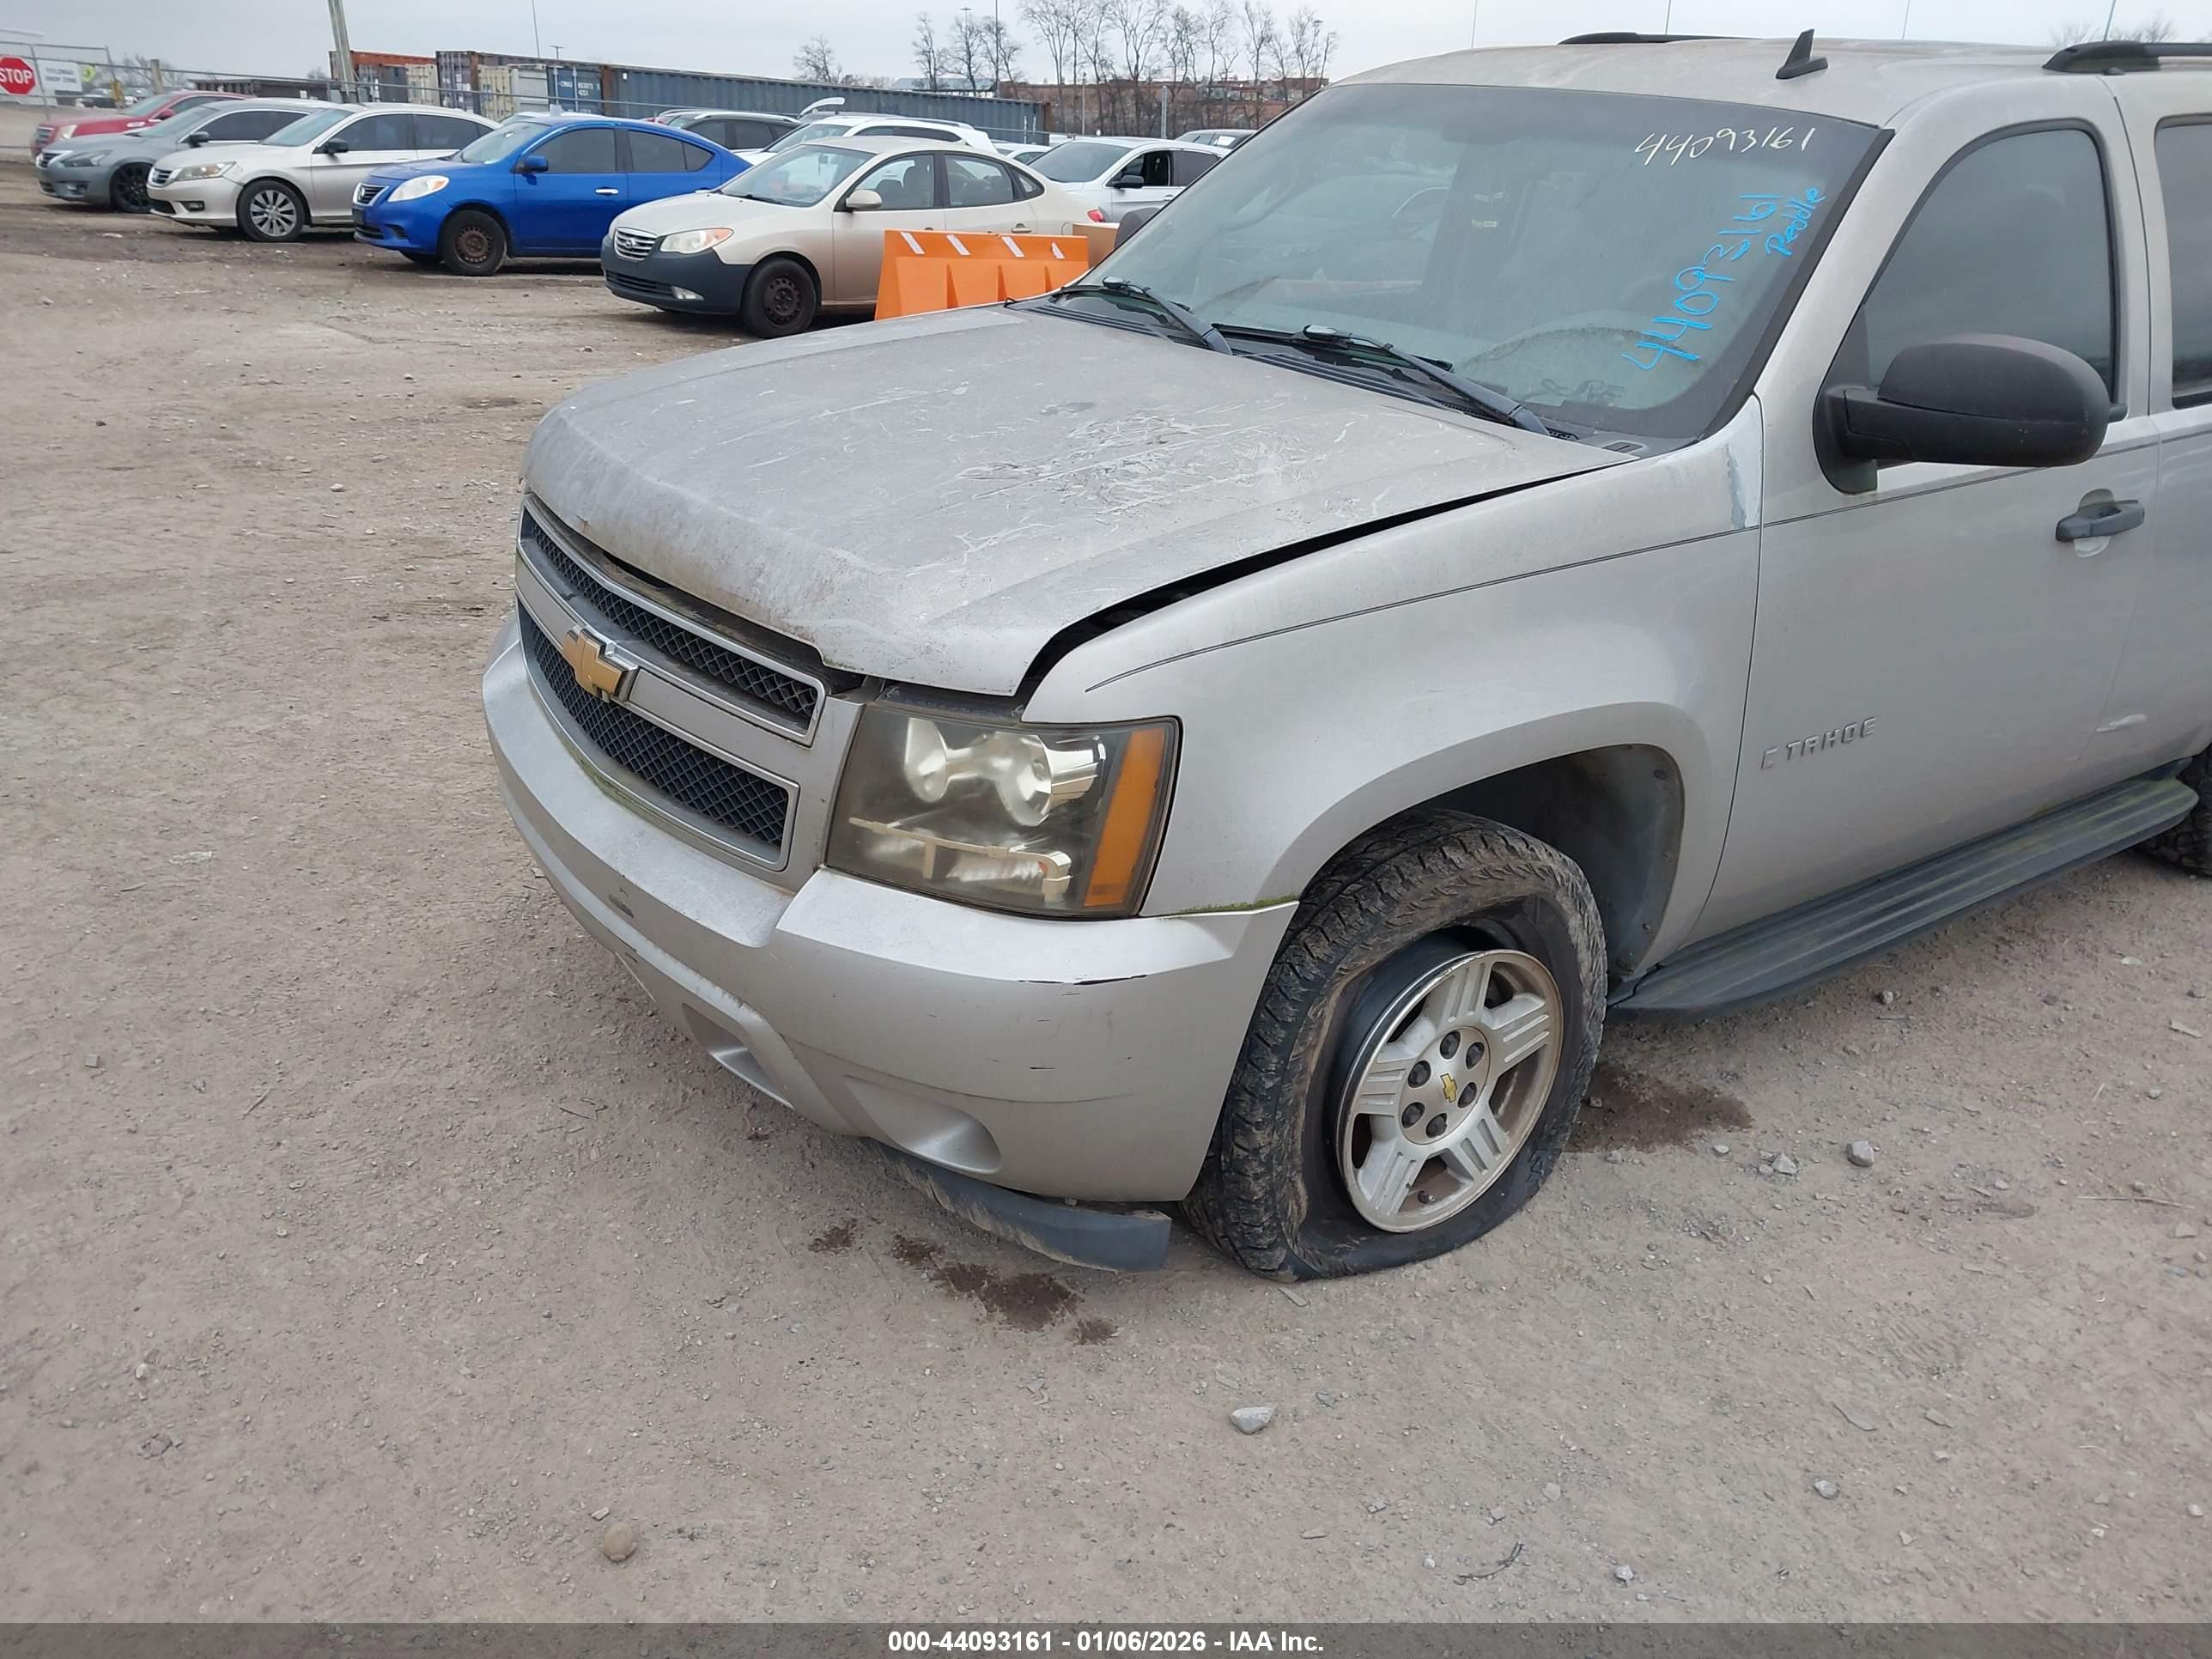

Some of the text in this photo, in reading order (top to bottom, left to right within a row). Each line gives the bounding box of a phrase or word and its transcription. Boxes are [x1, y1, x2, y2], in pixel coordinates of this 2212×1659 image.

[0, 68, 33, 84] STOP
[1634, 127, 1816, 166] 44093161
[1621, 192, 1784, 370] 44093161
[1786, 716, 1876, 761] TAHOE
